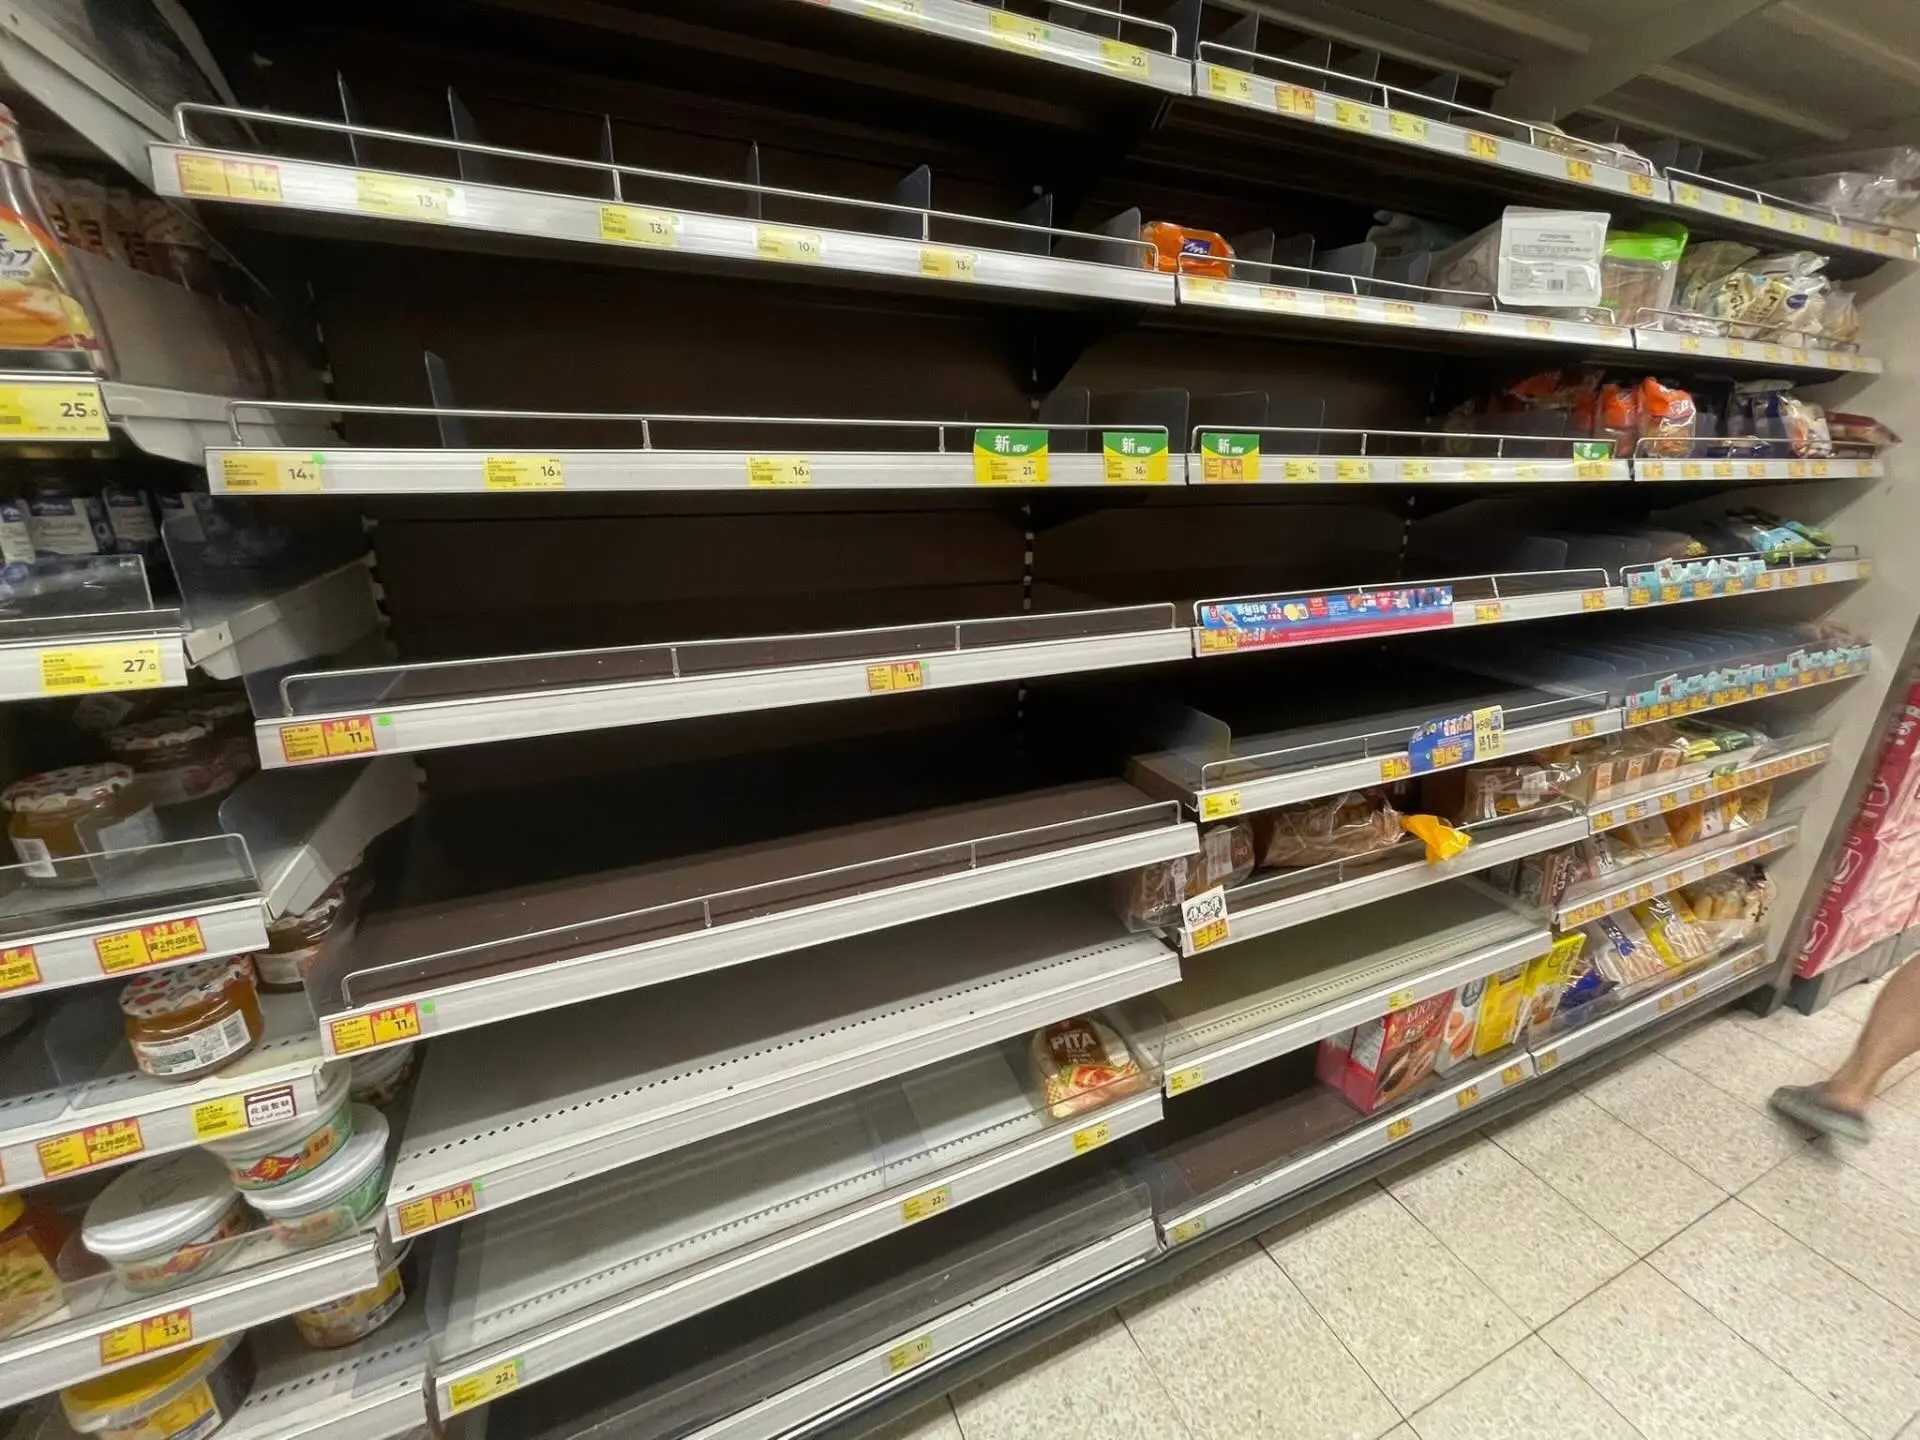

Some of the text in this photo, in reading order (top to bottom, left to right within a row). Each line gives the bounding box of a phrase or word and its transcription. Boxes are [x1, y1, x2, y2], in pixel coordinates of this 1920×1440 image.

[60, 402, 98, 418] 25.0
[994, 434, 1010, 453] 新
[1121, 436, 1136, 454] 新
[1217, 437, 1230, 455] 新
[123, 658, 157, 673] 27.0
[1050, 1031, 1096, 1050] PITA
